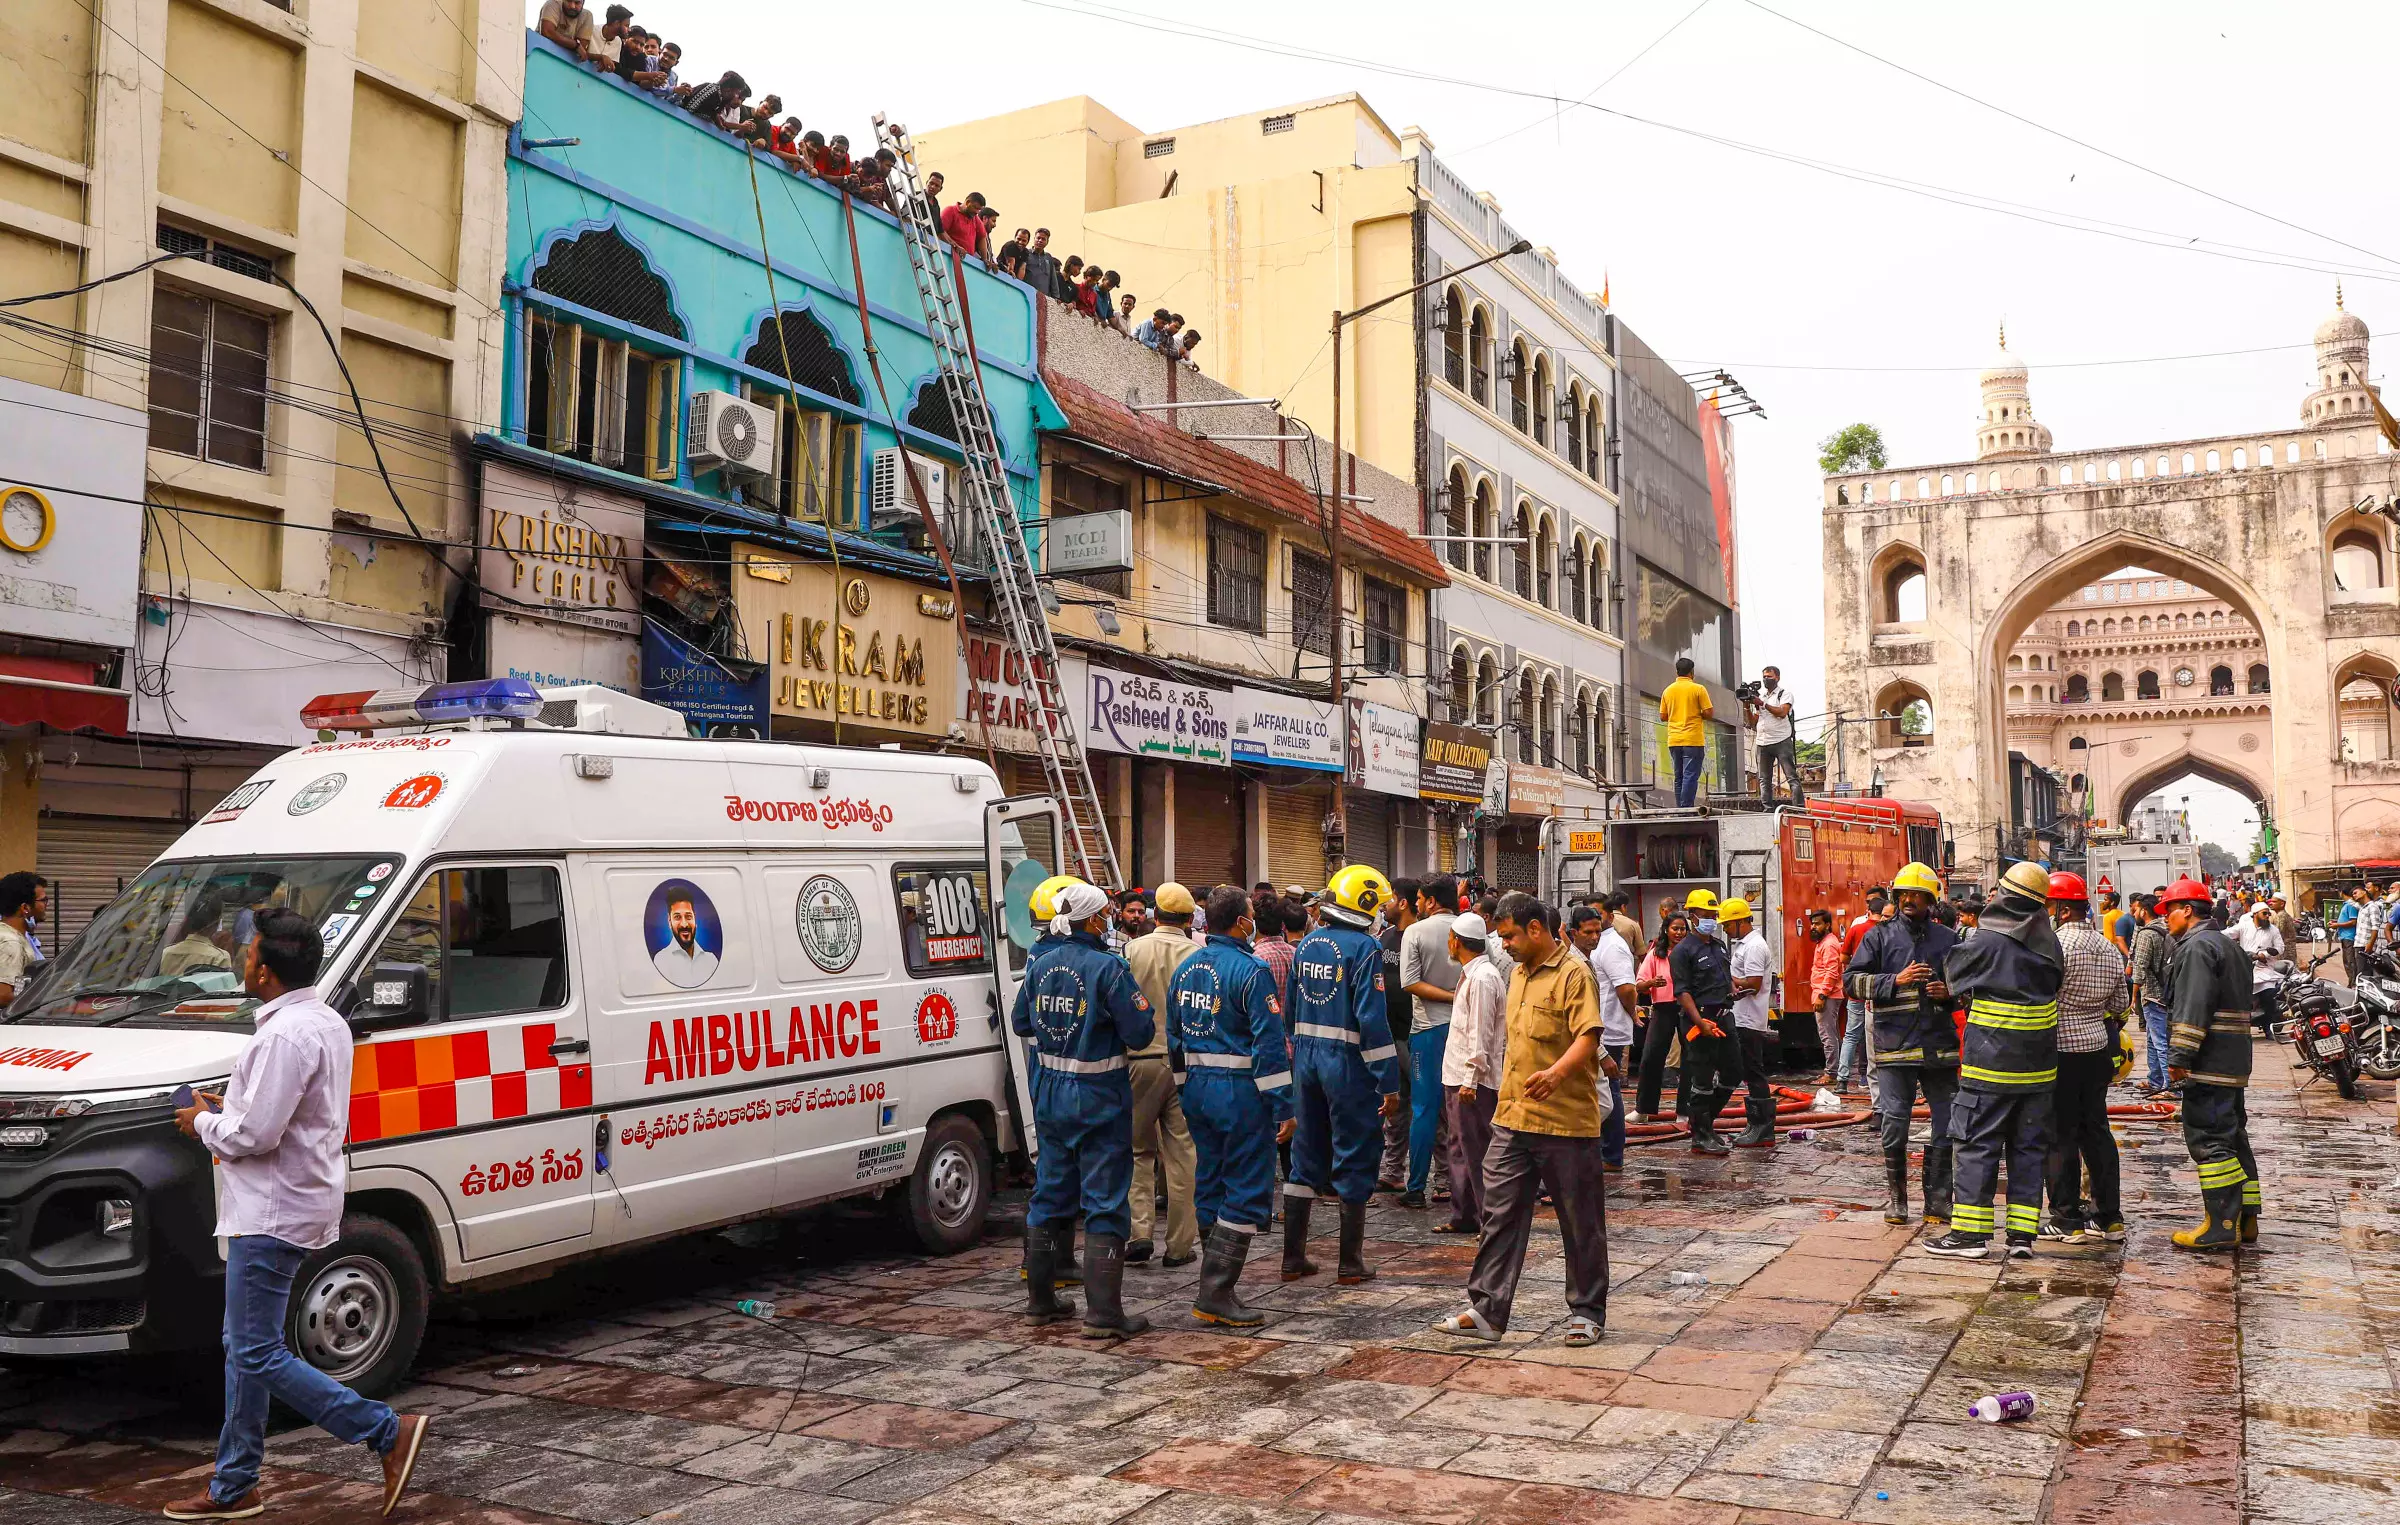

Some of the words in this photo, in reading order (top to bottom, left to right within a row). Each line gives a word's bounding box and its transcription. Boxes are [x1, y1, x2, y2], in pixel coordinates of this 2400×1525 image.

[1064, 530, 1107, 548] MODI
[1064, 545, 1108, 560] PEARLS
[513, 560, 617, 607] PEARLS
[567, 612, 604, 625] CERTIFIED
[605, 619, 629, 631] STORE
[782, 611, 926, 686] IKRAM
[535, 672, 545, 686] By
[778, 675, 928, 725] JEWELLERS
[1167, 690, 1177, 704] &
[690, 711, 725, 719] Telangana
[701, 703, 730, 711] Certified
[732, 704, 747, 712] regd
[1090, 674, 1170, 753] Rasheed
[1175, 707, 1187, 734] &
[1192, 710, 1227, 740] Sons
[1253, 712, 1288, 732] JAFFAR
[1289, 718, 1304, 735] ALI
[1305, 720, 1312, 736] &
[1314, 722, 1329, 738] CO.
[1367, 709, 1402, 747] Telangana
[1273, 735, 1310, 749] JEWELLERS
[1425, 738, 1445, 761] SAIF
[1444, 741, 1490, 770] COLLECTION
[724, 795, 818, 822] తెలంగాణ
[819, 795, 893, 832] ప్రభుత్వం
[1576, 834, 1583, 842] TS
[1588, 834, 1596, 842] 07
[1576, 842, 1601, 851] UA4587
[1799, 840, 1812, 858] 101
[372, 867, 389, 877] 38
[801, 883, 819, 923] GOVERNMENT
[832, 884, 856, 921] TELANGANA
[925, 876, 976, 936] 108
[926, 897, 936, 936] CALL
[927, 937, 982, 960] EMERGENCY
[1329, 940, 1342, 960] STATE
[1302, 961, 1333, 980] FIRE
[1069, 971, 1086, 992] STATE
[1041, 995, 1074, 1014] FIRE
[1180, 990, 1212, 1010] FIRE
[912, 997, 923, 1047] NATIONAL
[923, 987, 947, 998] HEALTH
[948, 995, 960, 1038] MISSION
[644, 998, 881, 1085] AMBULANCE
[621, 1113, 689, 1150] అత్యవసర
[693, 1100, 771, 1131] సేవలకొరకు
[775, 1090, 804, 1116] కాల్
[806, 1084, 857, 1112] చేయండి
[859, 1082, 886, 1103] 108
[857, 1157, 878, 1169] HEALTH
[878, 1152, 906, 1165] SERVICES
[858, 1147, 879, 1161] EMRI
[881, 1140, 907, 1155] GREEN
[460, 1155, 535, 1197] ఉచిత
[540, 1147, 583, 1184] సేవ
[856, 1168, 872, 1180] GVK
[873, 1164, 904, 1175] Enterprise
